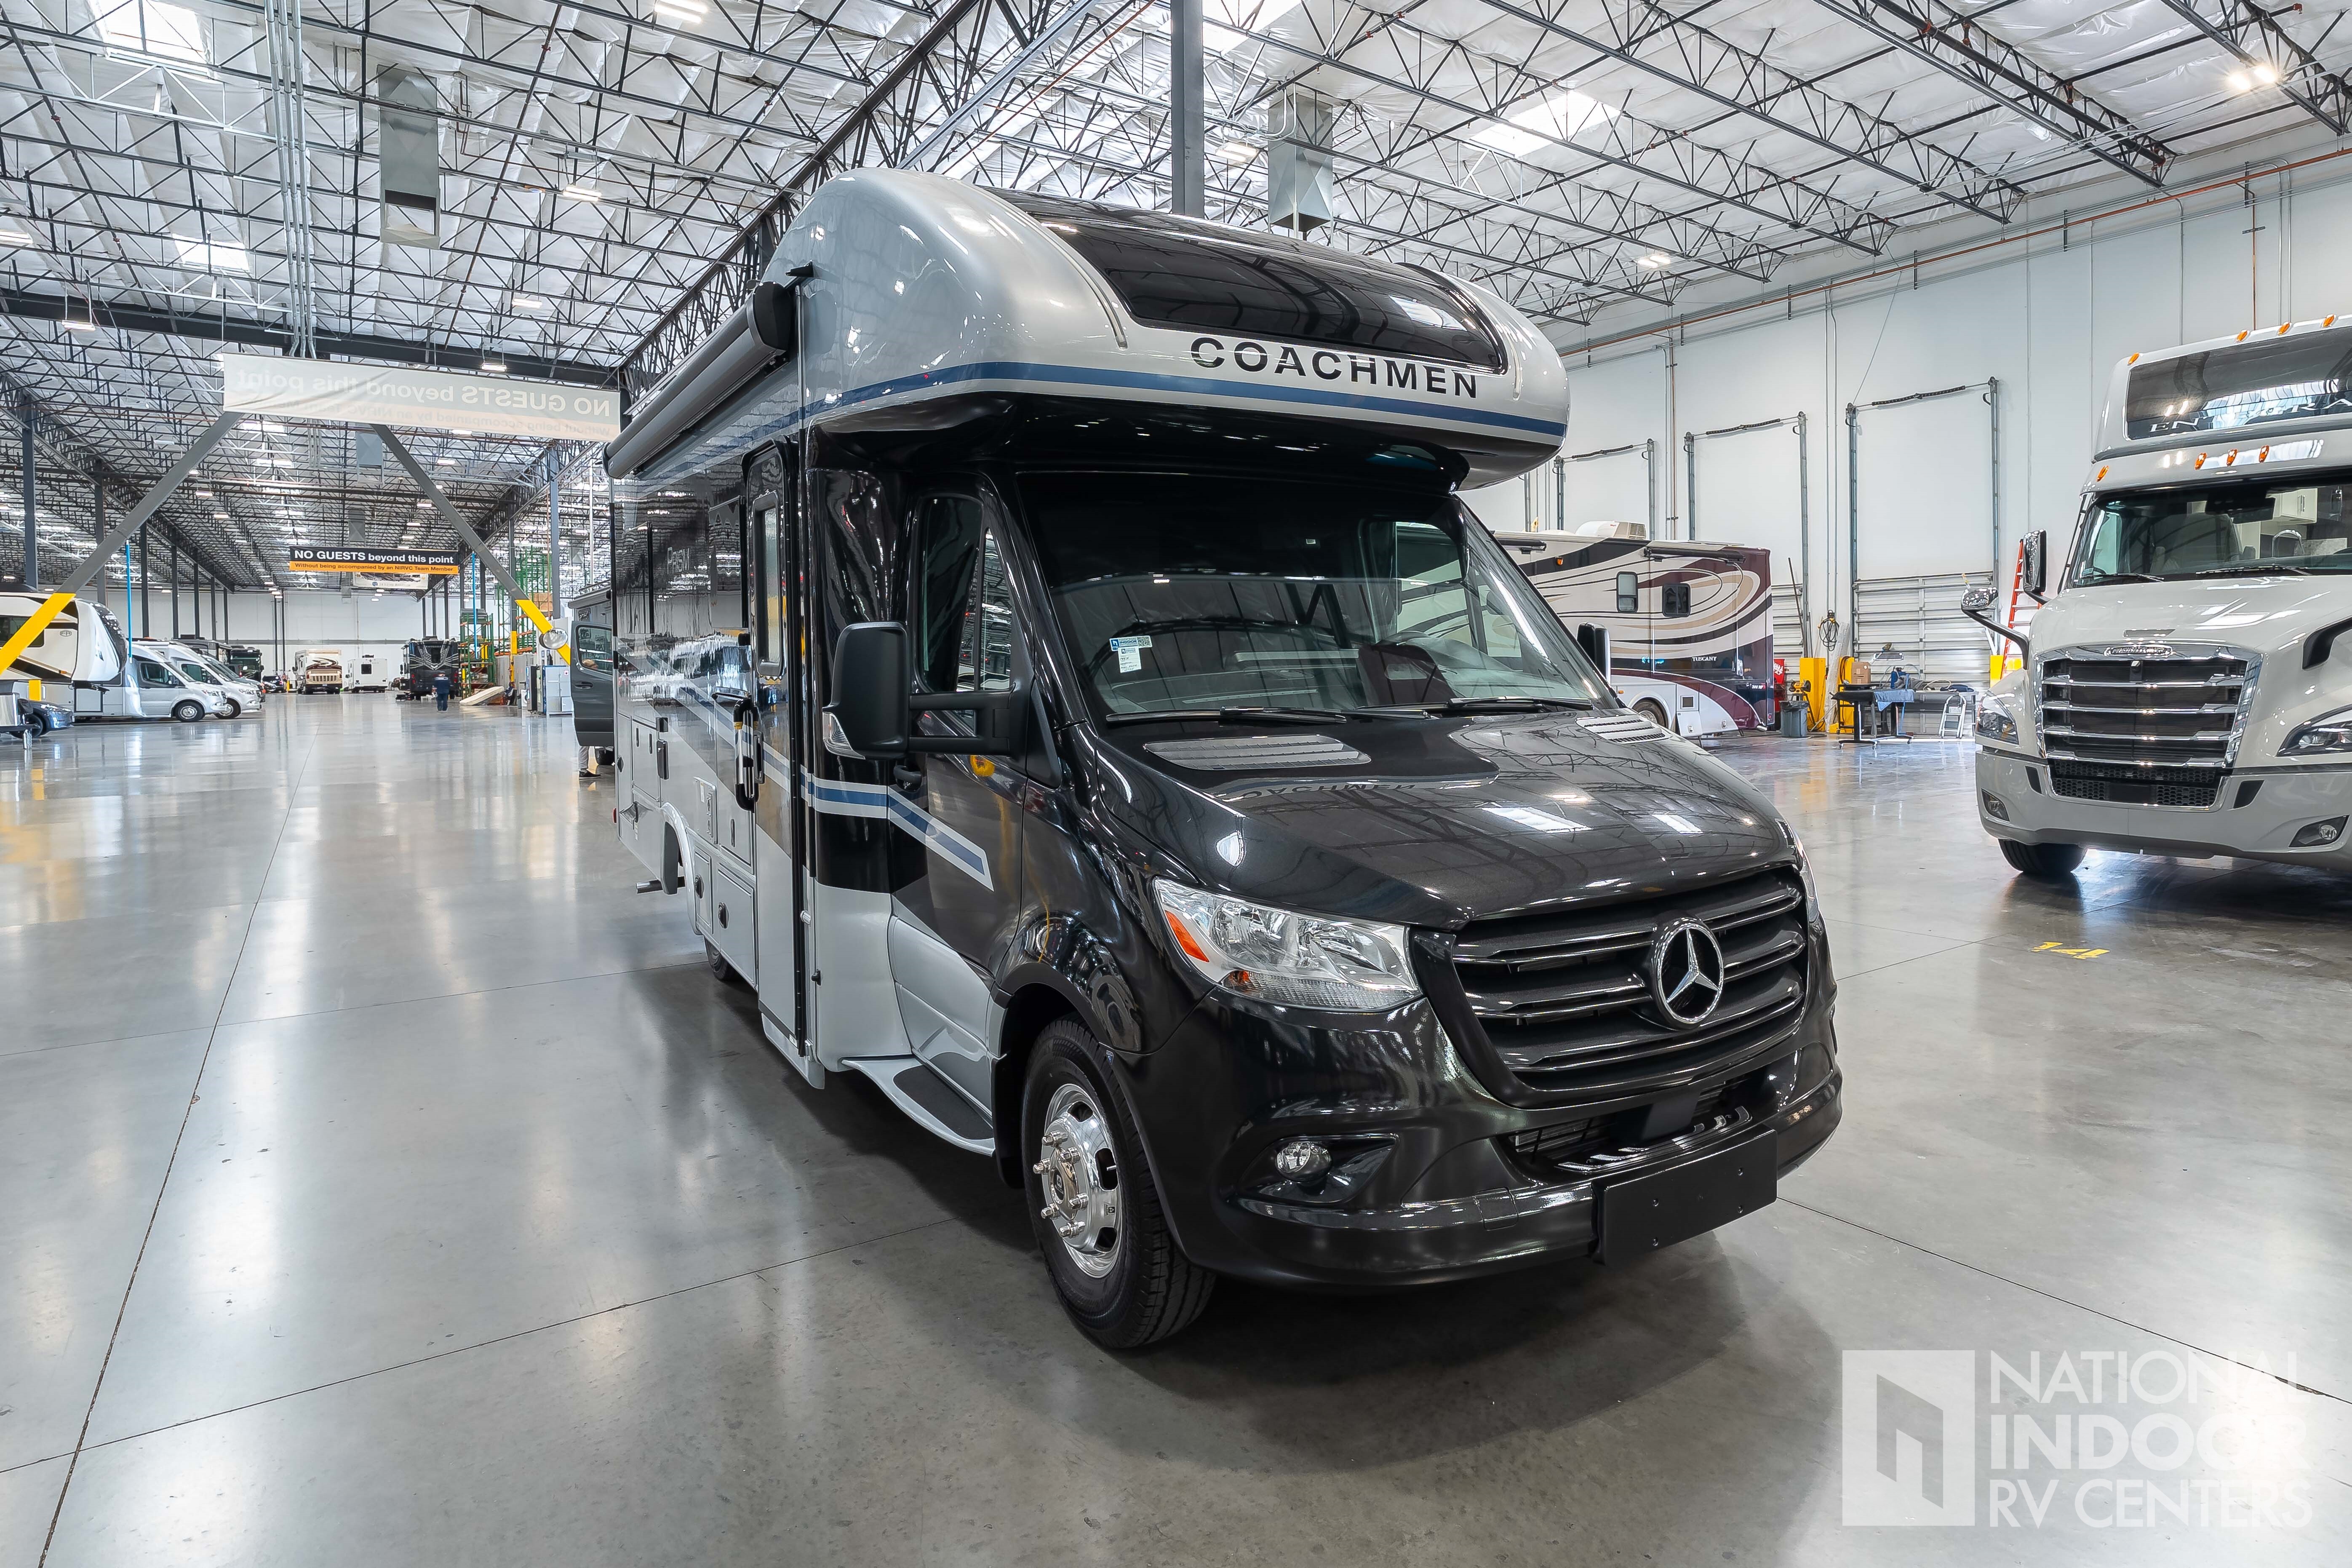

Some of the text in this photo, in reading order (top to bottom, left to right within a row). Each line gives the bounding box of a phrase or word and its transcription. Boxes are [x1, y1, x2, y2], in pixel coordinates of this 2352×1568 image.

[1190, 337, 1477, 398] COACHMEN
[295, 550, 314, 559] NO
[316, 550, 366, 561] GUESTS
[368, 553, 405, 563] beyond
[429, 556, 454, 564] point
[667, 547, 689, 574] PRISM
